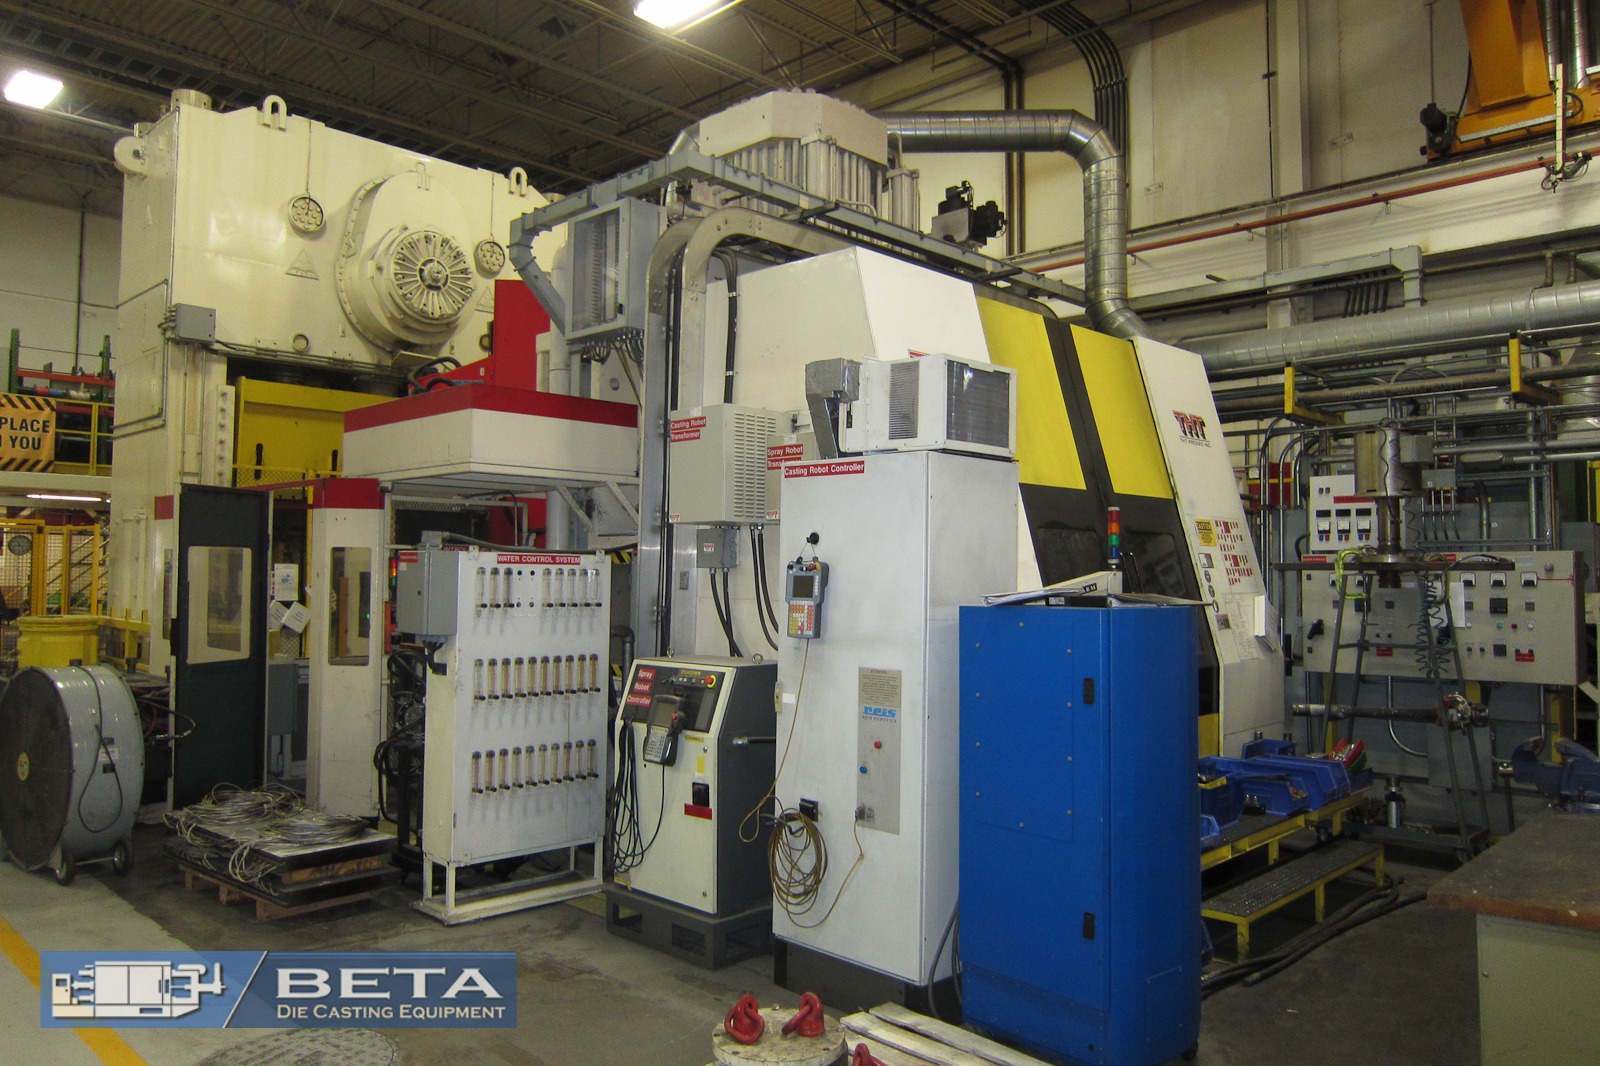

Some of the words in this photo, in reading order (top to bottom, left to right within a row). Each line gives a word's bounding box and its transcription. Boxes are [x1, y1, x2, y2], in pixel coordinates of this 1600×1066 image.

[690, 418, 706, 426] Robot
[1172, 410, 1206, 440] THT
[671, 431, 700, 440] Transformer
[9, 435, 42, 450] YOU
[767, 448, 784, 457] Spray
[785, 446, 803, 454] Robot
[784, 467, 808, 476] Casting
[809, 465, 829, 474] Robot
[830, 462, 864, 472] Controller
[521, 555, 554, 563] CONTROL
[638, 670, 653, 678] Spray
[634, 682, 650, 690] Robot
[627, 695, 651, 704] Controller
